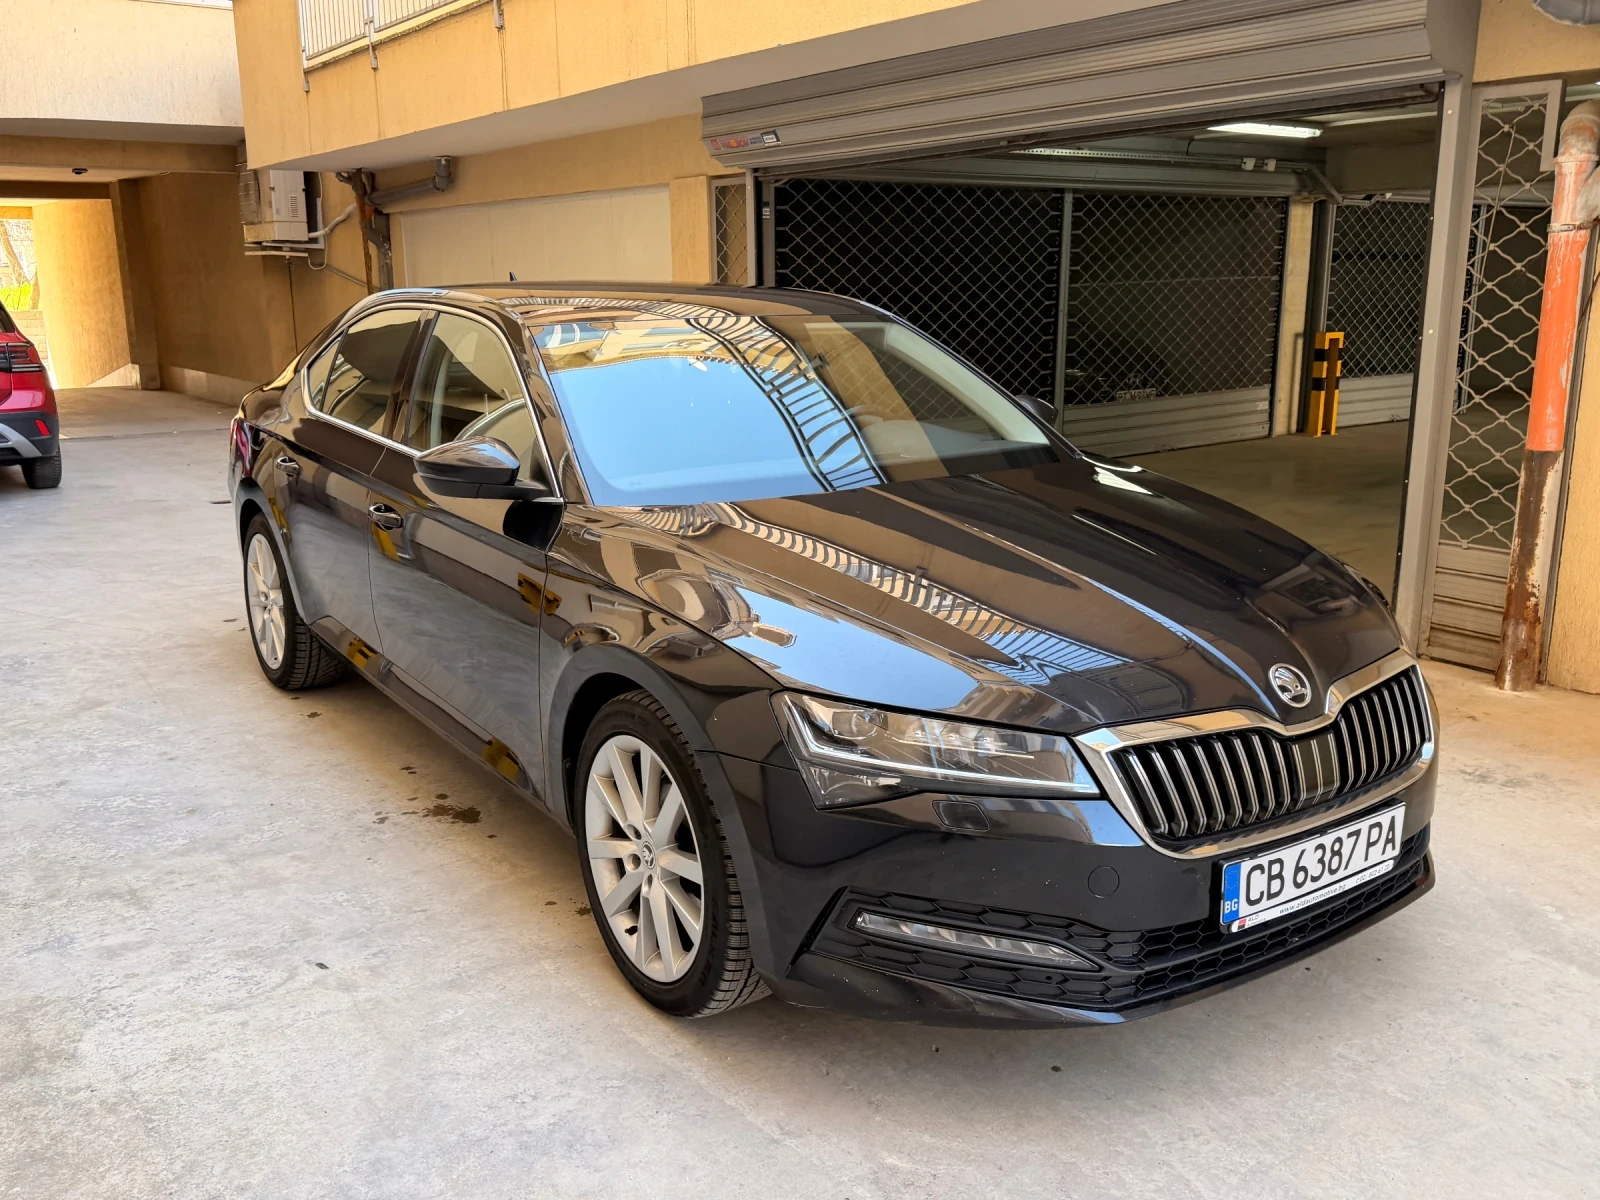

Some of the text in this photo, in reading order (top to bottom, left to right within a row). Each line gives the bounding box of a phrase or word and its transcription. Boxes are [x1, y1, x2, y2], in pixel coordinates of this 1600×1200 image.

[1245, 815, 1396, 907] CB 6387 PA
[1225, 898, 1238, 914] BG
